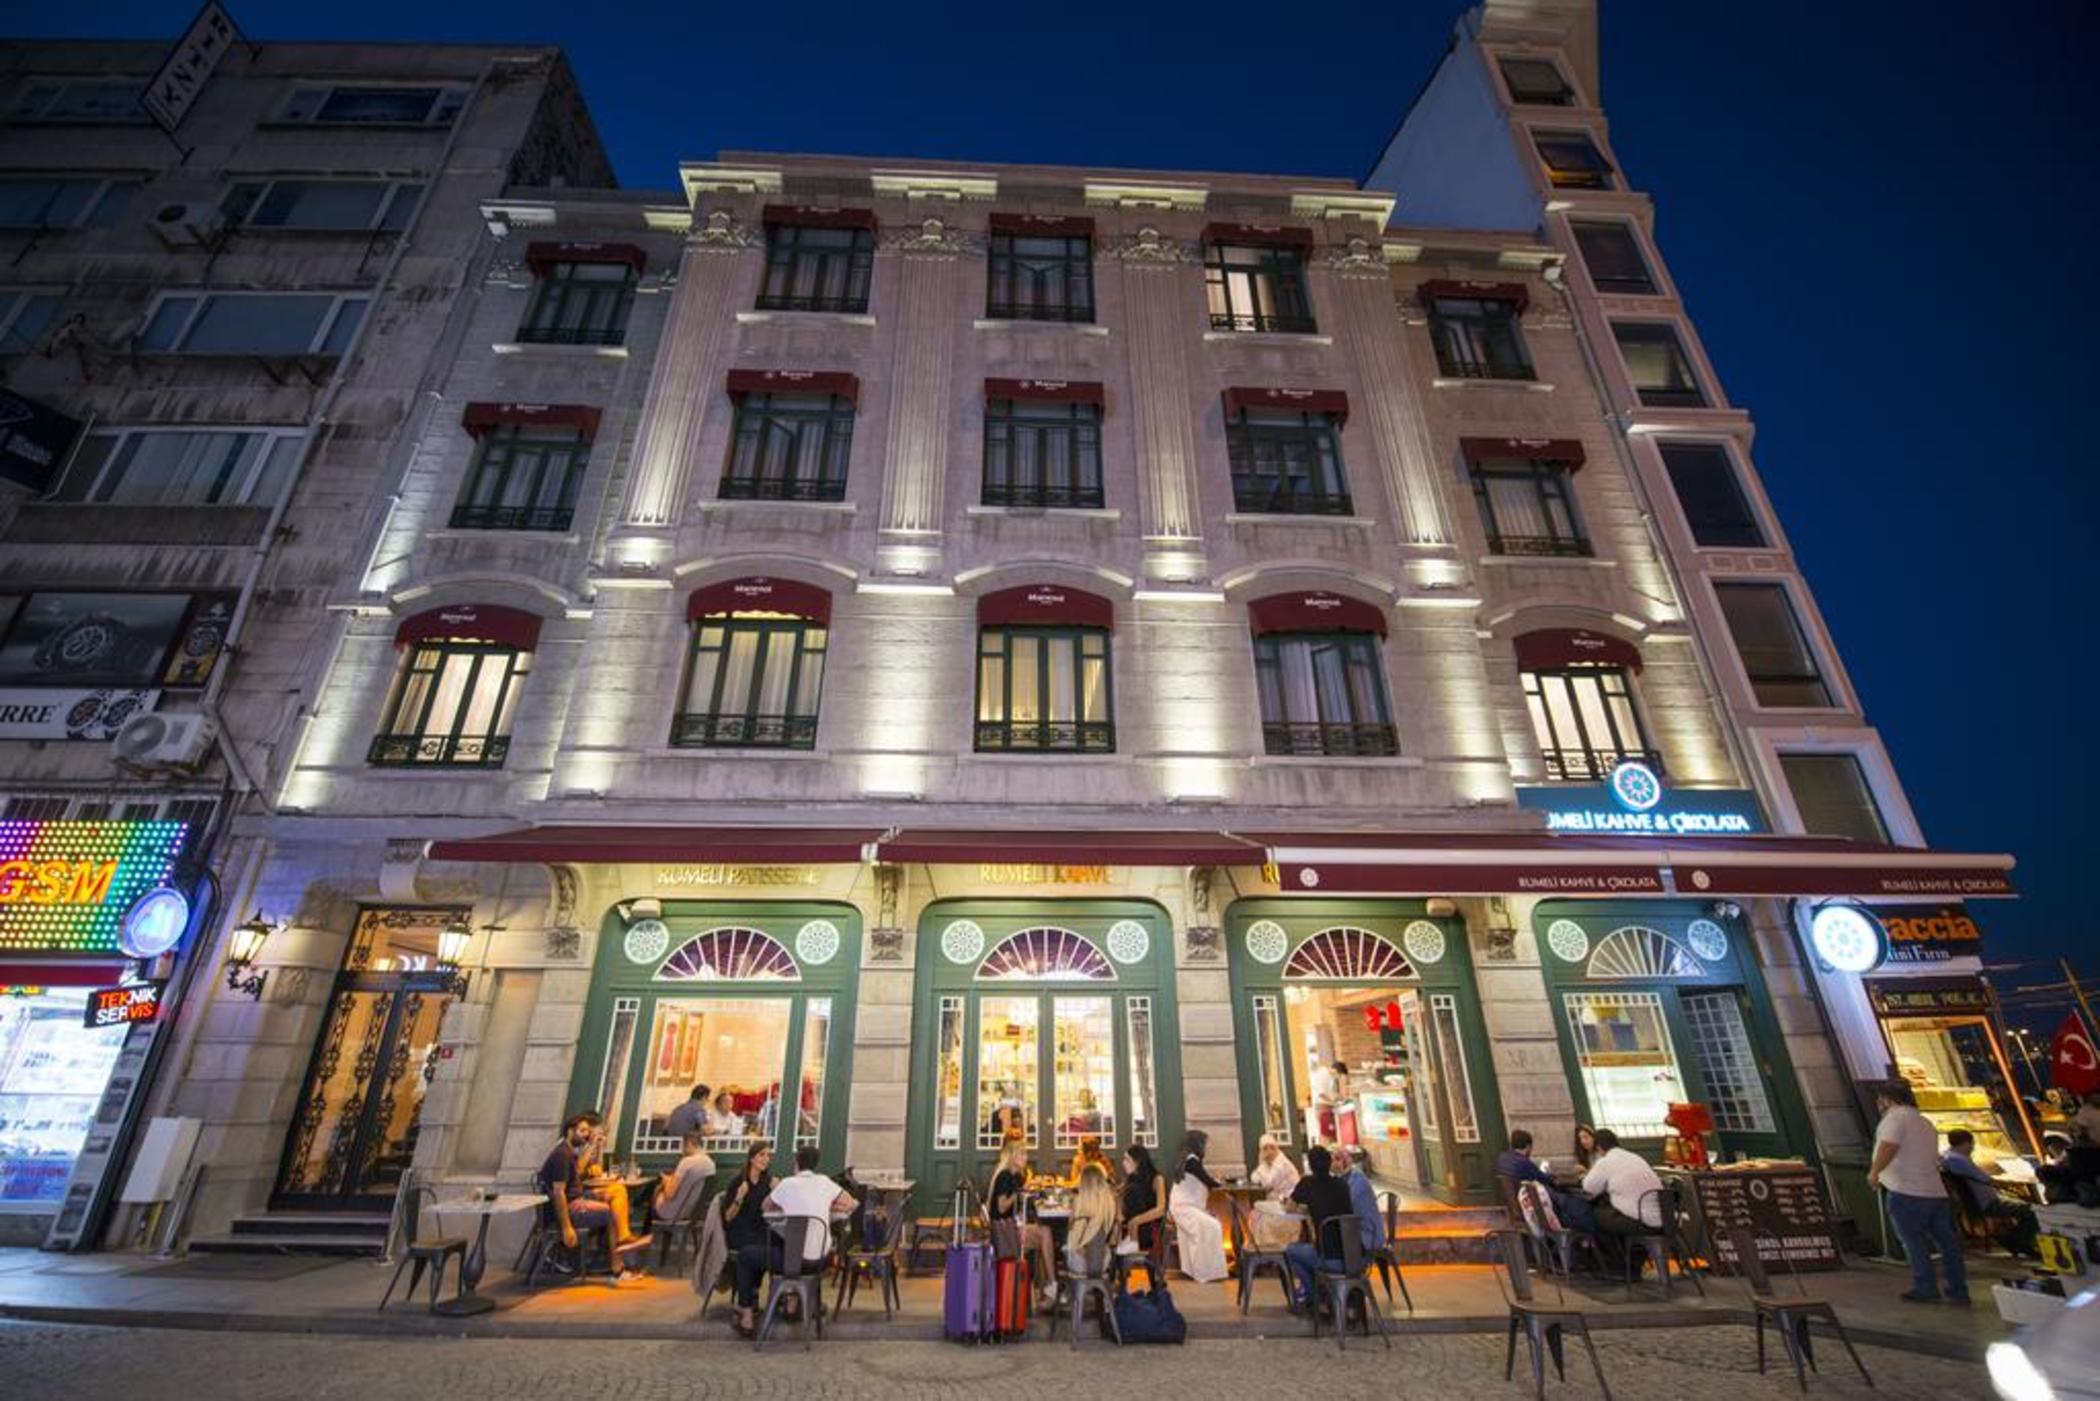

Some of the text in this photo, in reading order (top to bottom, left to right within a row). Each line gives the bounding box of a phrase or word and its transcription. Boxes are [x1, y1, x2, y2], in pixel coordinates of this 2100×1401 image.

[1546, 811, 1592, 830] UMELİ
[1594, 814, 1654, 830] KAHVE
[1655, 814, 1670, 830] &
[0, 859, 118, 905] GSM
